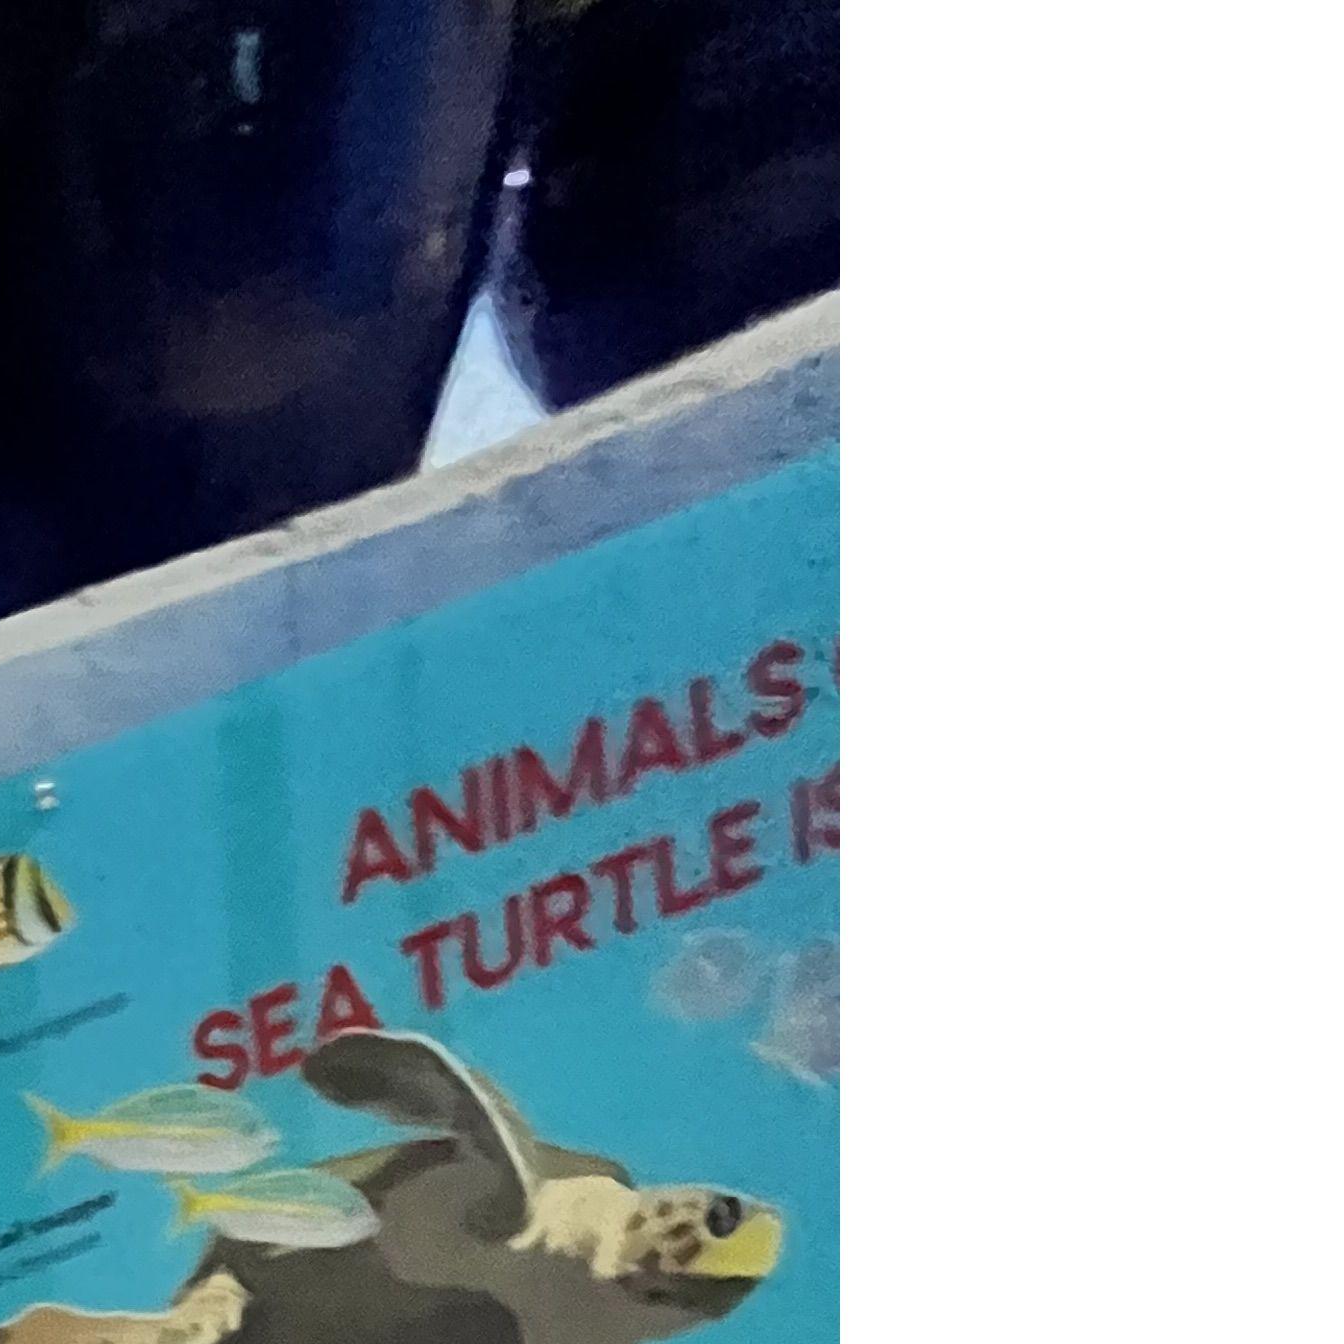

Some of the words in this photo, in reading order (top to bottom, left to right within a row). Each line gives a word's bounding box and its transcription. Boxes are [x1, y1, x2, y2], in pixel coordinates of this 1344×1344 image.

[340, 638, 806, 903] ANIMALS
[193, 964, 385, 1091] SEA
[401, 803, 764, 1008] TURTLE
